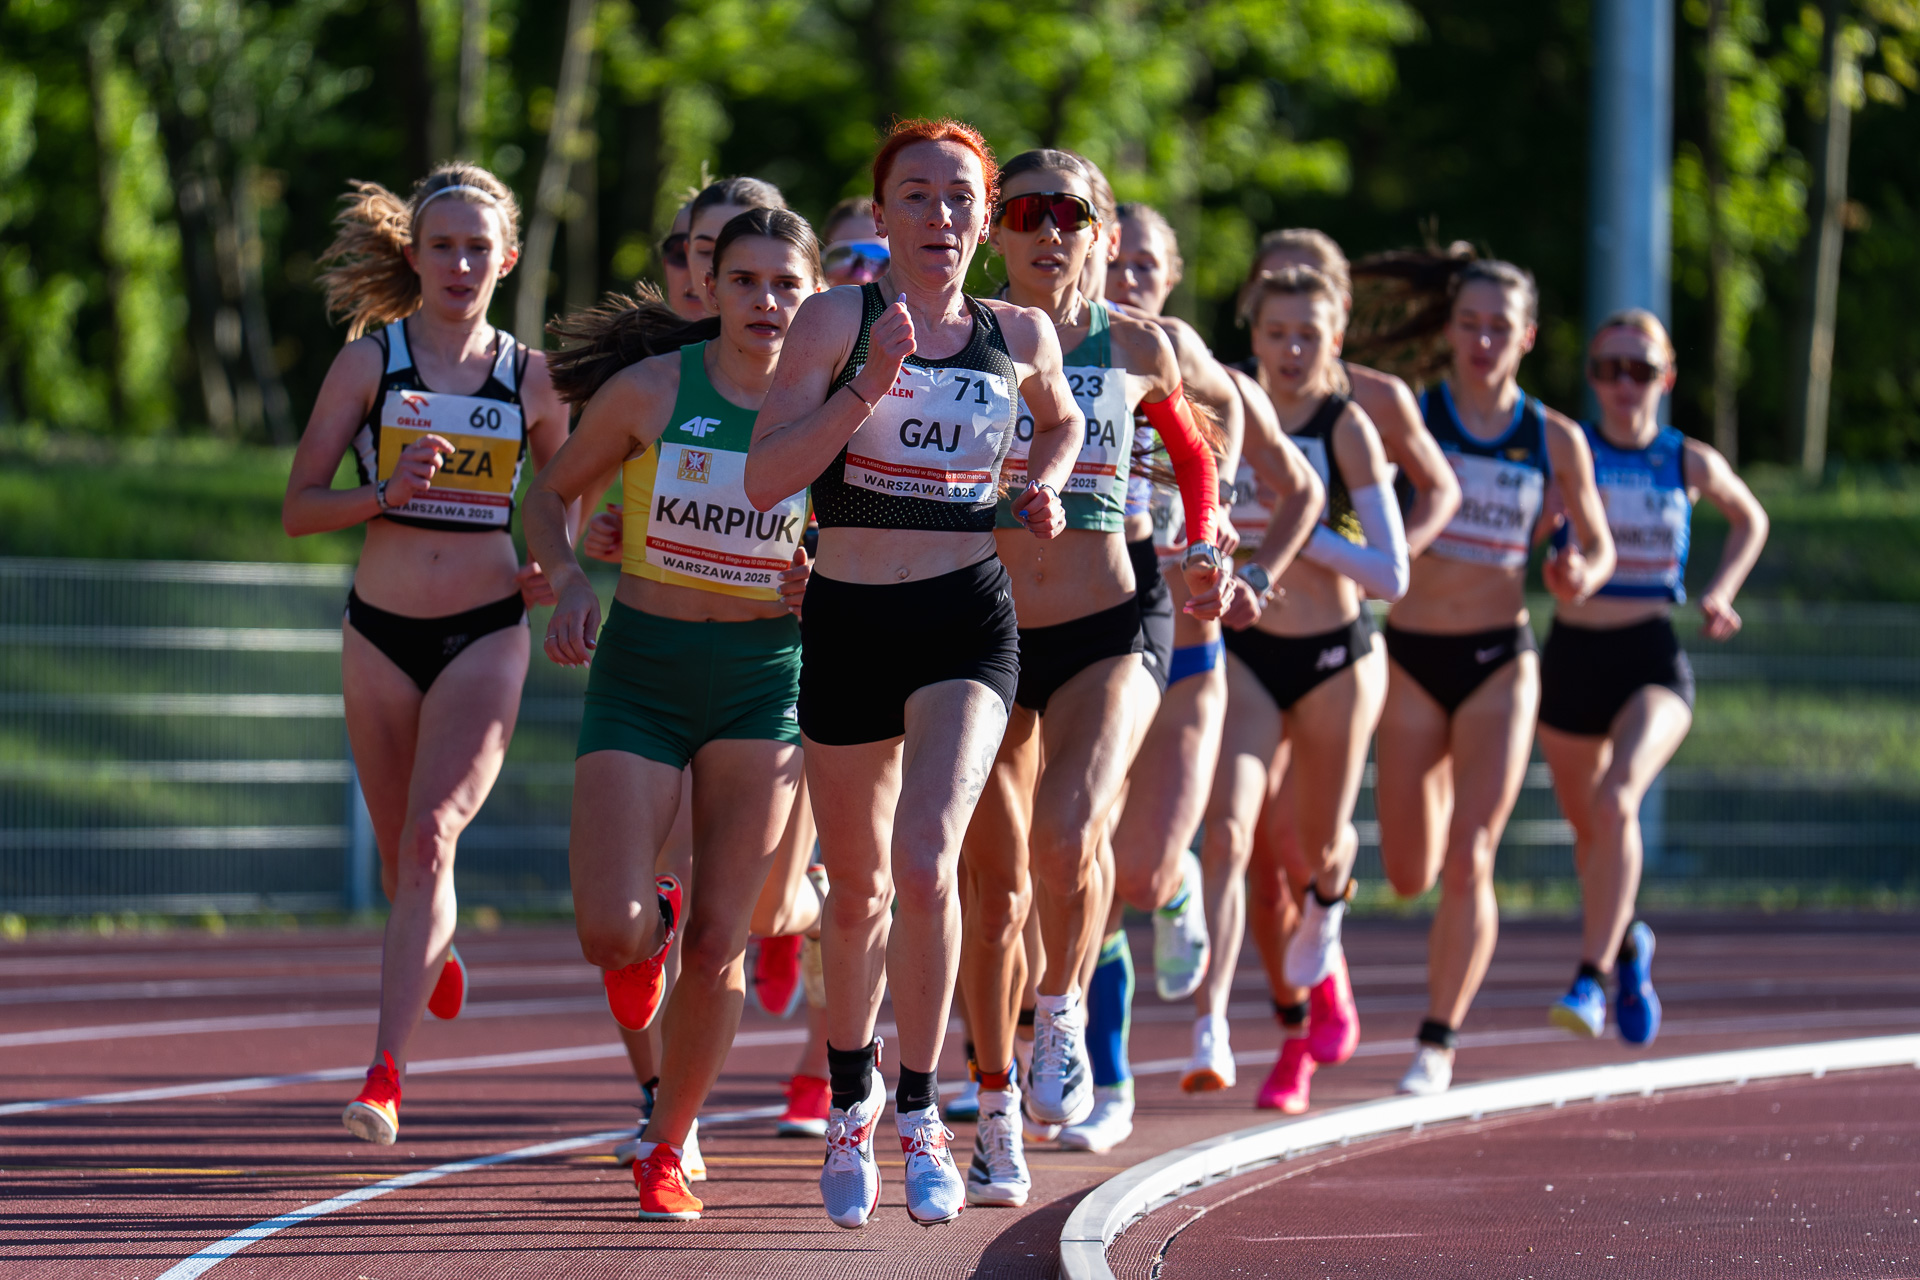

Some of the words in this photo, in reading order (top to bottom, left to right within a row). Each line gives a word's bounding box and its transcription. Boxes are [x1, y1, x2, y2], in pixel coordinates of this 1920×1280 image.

[886, 387, 914, 399] LEN
[954, 376, 989, 404] 71
[1068, 374, 1103, 398] 23
[397, 416, 432, 428] ORLEN
[469, 406, 502, 430] 60
[680, 416, 721, 438] 4F
[900, 418, 962, 453] GAJ
[852, 456, 866, 465] PZLA
[867, 460, 902, 473] Mistrzostwa
[927, 471, 945, 480] Biegu
[864, 473, 945, 497] WARSZAWA
[947, 487, 976, 498] 2025
[1071, 477, 1097, 488] 2025
[468, 507, 494, 519] 2025
[656, 495, 799, 544] KARPIUK
[652, 540, 666, 548] PZLA
[666, 543, 701, 556] Mistrzostwa
[701, 551, 719, 559] Polski
[725, 555, 742, 565] Biegu
[663, 556, 742, 582] WARSZAWA
[744, 572, 772, 584] 2025
